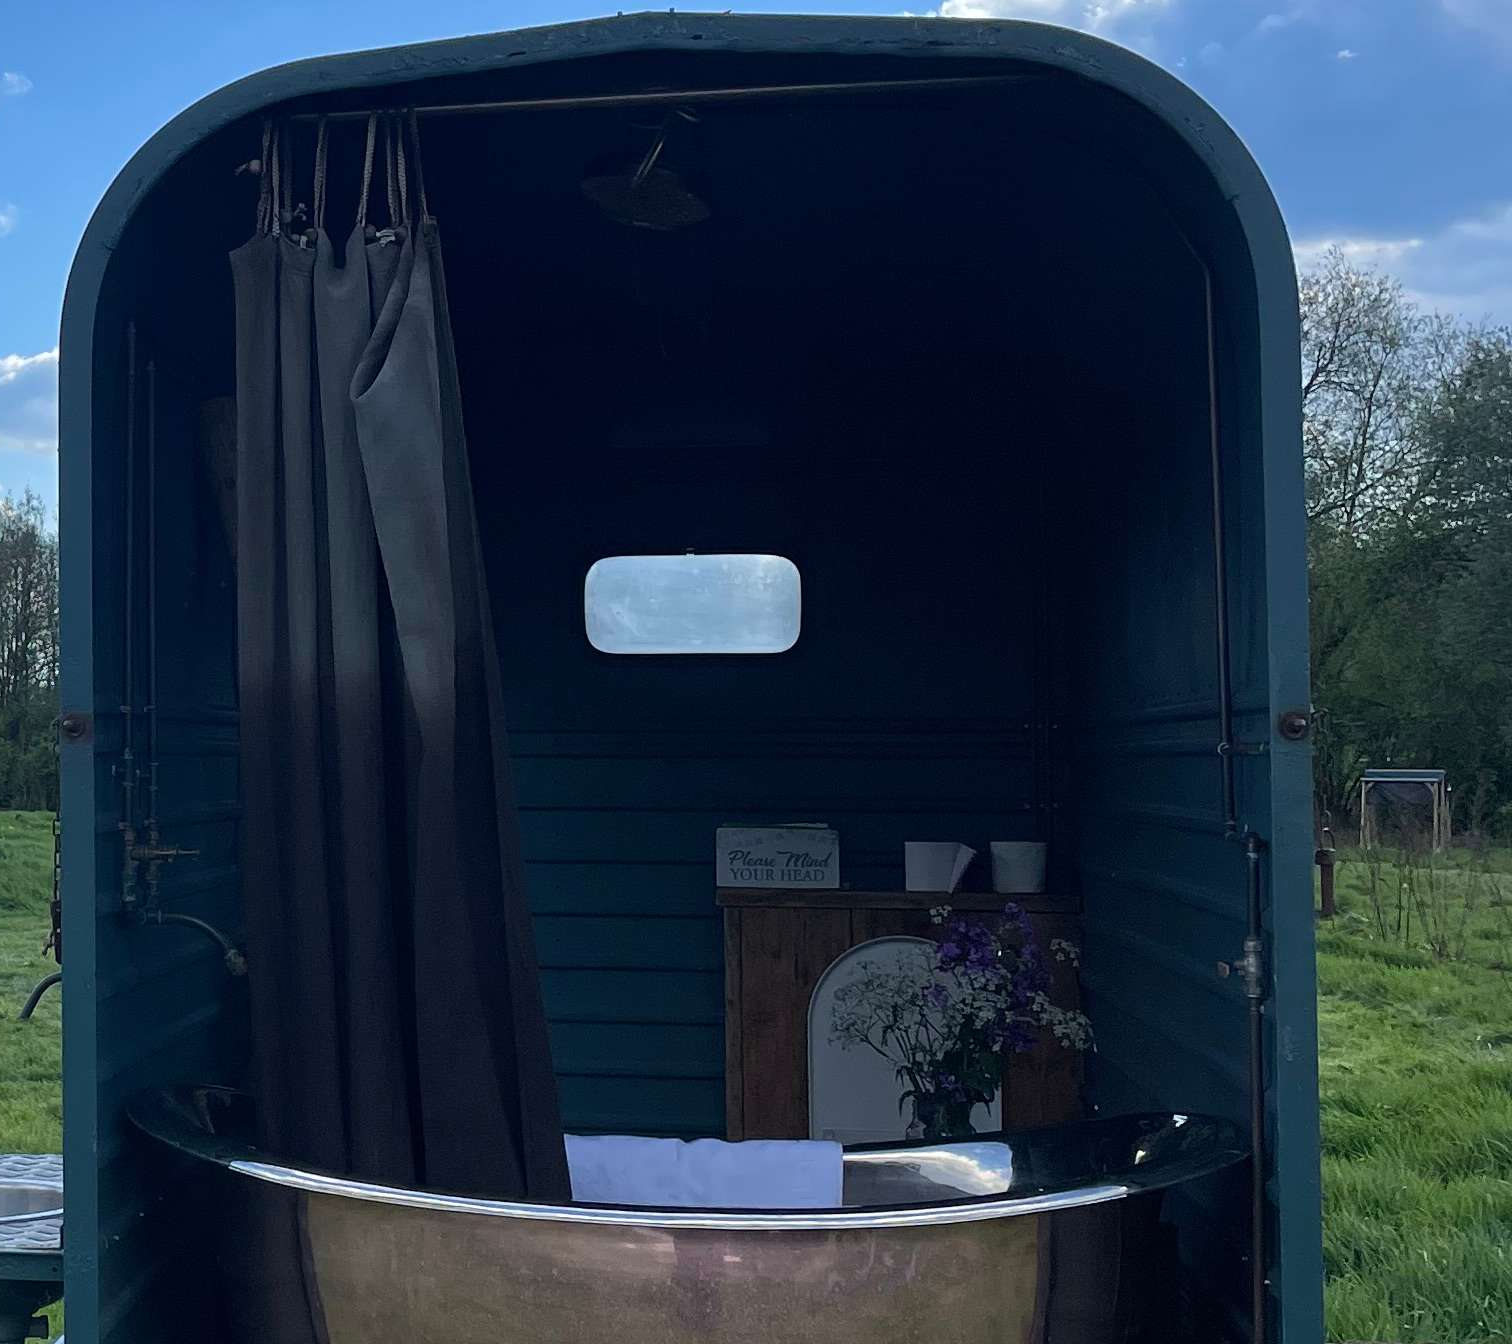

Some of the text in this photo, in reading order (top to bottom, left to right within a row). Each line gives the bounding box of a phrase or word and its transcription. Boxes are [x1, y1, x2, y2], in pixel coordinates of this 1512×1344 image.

[728, 850, 832, 868] Please Mind
[729, 868, 825, 882] YOUR HEAD
